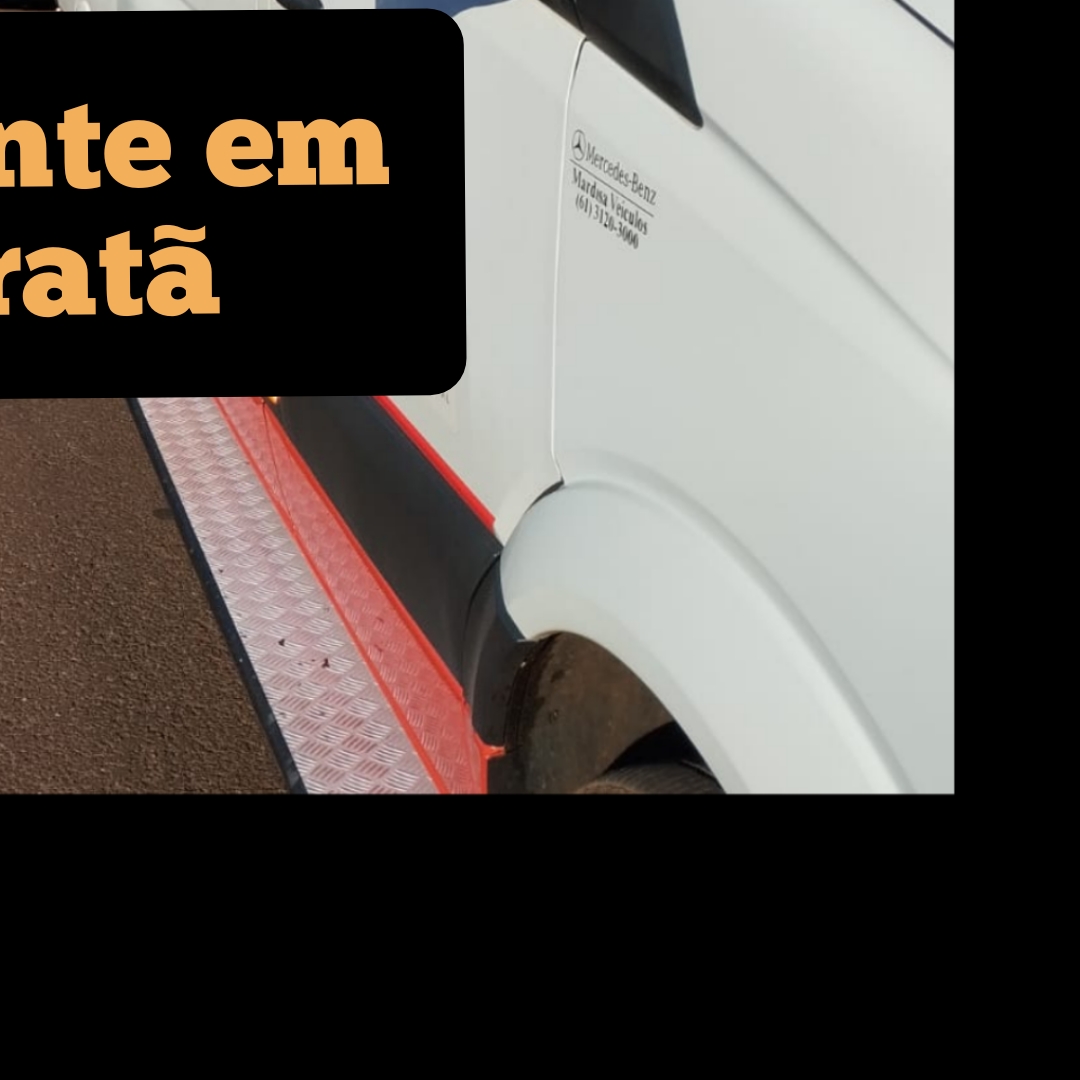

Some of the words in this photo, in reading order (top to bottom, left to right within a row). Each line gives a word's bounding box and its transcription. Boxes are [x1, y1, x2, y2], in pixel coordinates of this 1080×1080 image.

[572, 166, 609, 208] Mardisa
[585, 141, 657, 206] Mercedes-Benz
[575, 193, 593, 219] (61)
